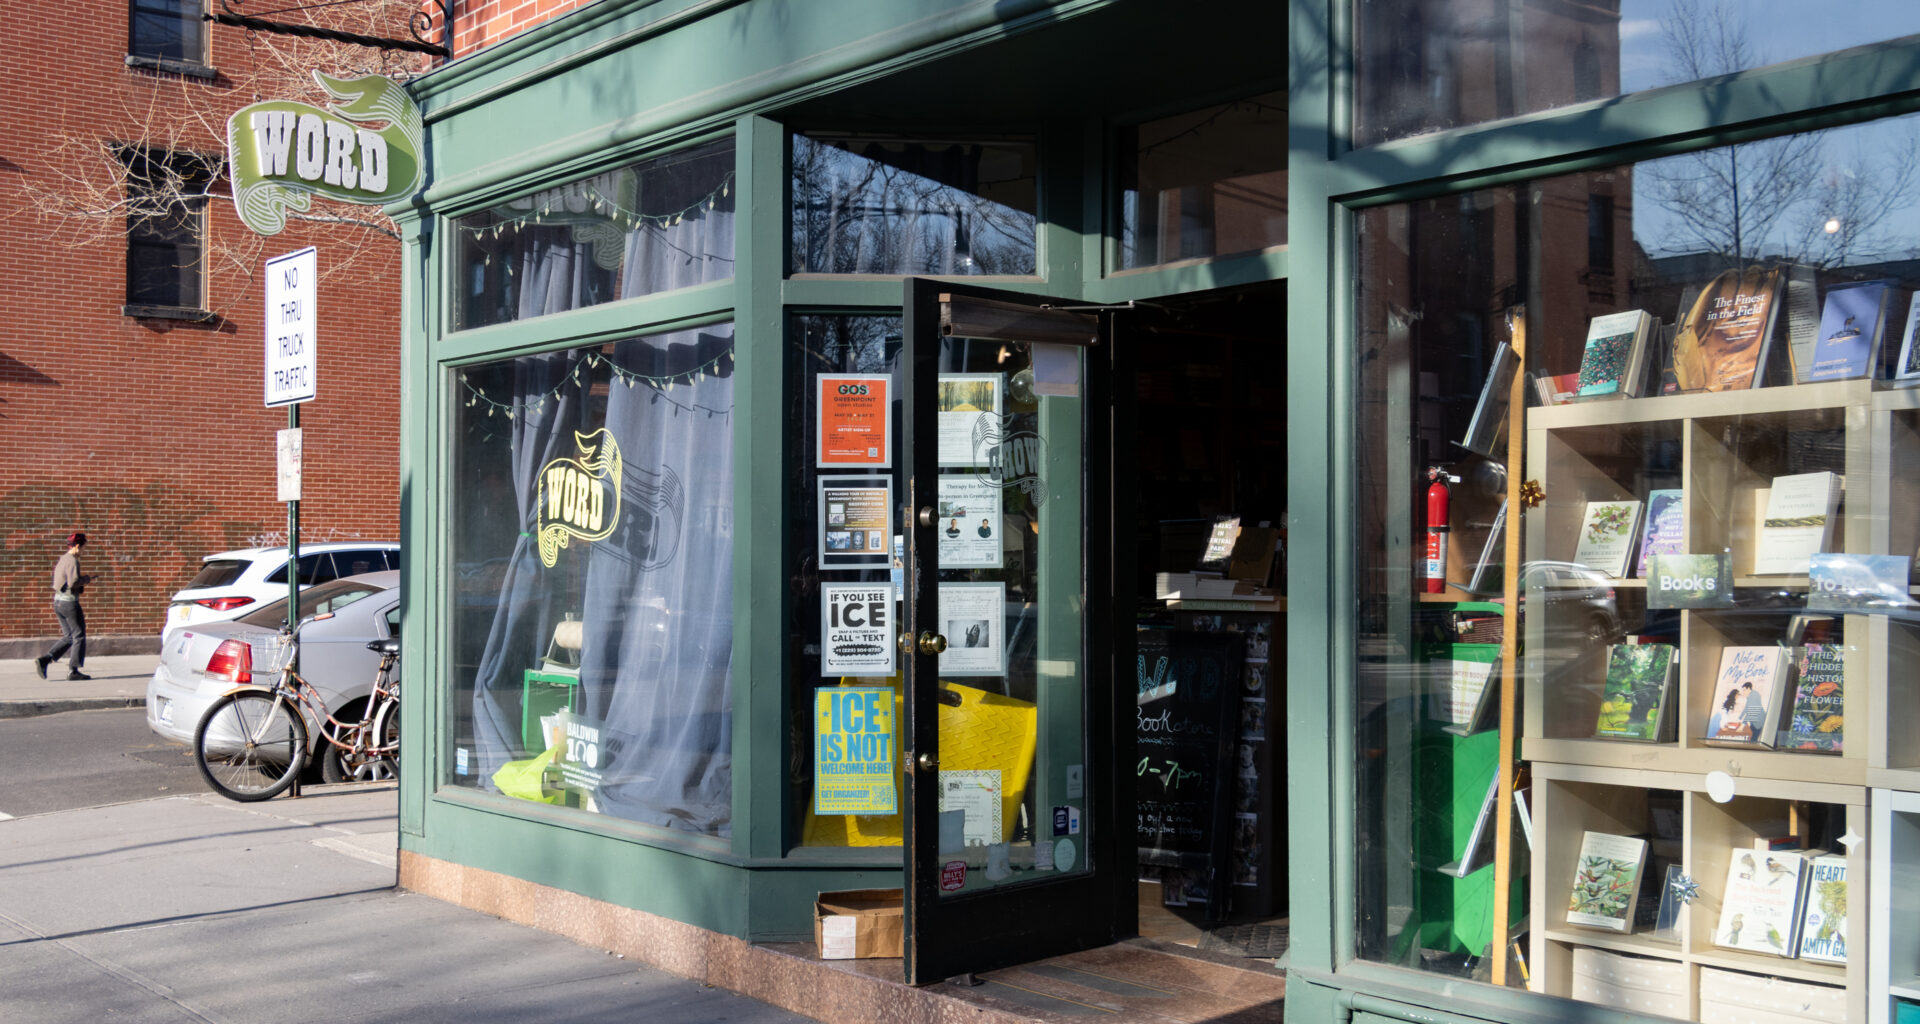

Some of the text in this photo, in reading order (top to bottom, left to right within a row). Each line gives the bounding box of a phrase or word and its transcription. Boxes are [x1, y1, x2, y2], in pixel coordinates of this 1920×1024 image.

[250, 110, 389, 194] WORD
[284, 266, 299, 291] NO
[1714, 293, 1766, 308] The Finest
[280, 298, 302, 325] THRU
[1706, 302, 1766, 321] in the Field
[278, 331, 304, 358] TRUCK
[274, 365, 308, 393] TRAFFIC
[838, 384, 869, 395] GOS
[547, 466, 604, 531] WORD
[1660, 574, 1716, 591] Books
[1815, 574, 1837, 592] to
[830, 592, 885, 602] IF YOU SEE
[830, 602, 886, 628] ICE
[831, 634, 854, 642] CALL
[862, 634, 886, 642] TEXT
[1733, 651, 1752, 665] Not
[1812, 651, 1833, 660] THE
[1723, 663, 1770, 683] My Book
[1809, 662, 1844, 671] HIDDE
[1804, 684, 1815, 693] of
[831, 692, 881, 734] ICE
[567, 722, 599, 744] BALDWIN
[820, 733, 891, 762] IS NOT
[820, 762, 892, 775] WELCOME HERE!
[1137, 756, 1202, 789] 0-7pm
[821, 790, 870, 798] GET ORGANIZED!
[1814, 864, 1847, 882] HEART
[1802, 937, 1847, 958] AMITY GA
